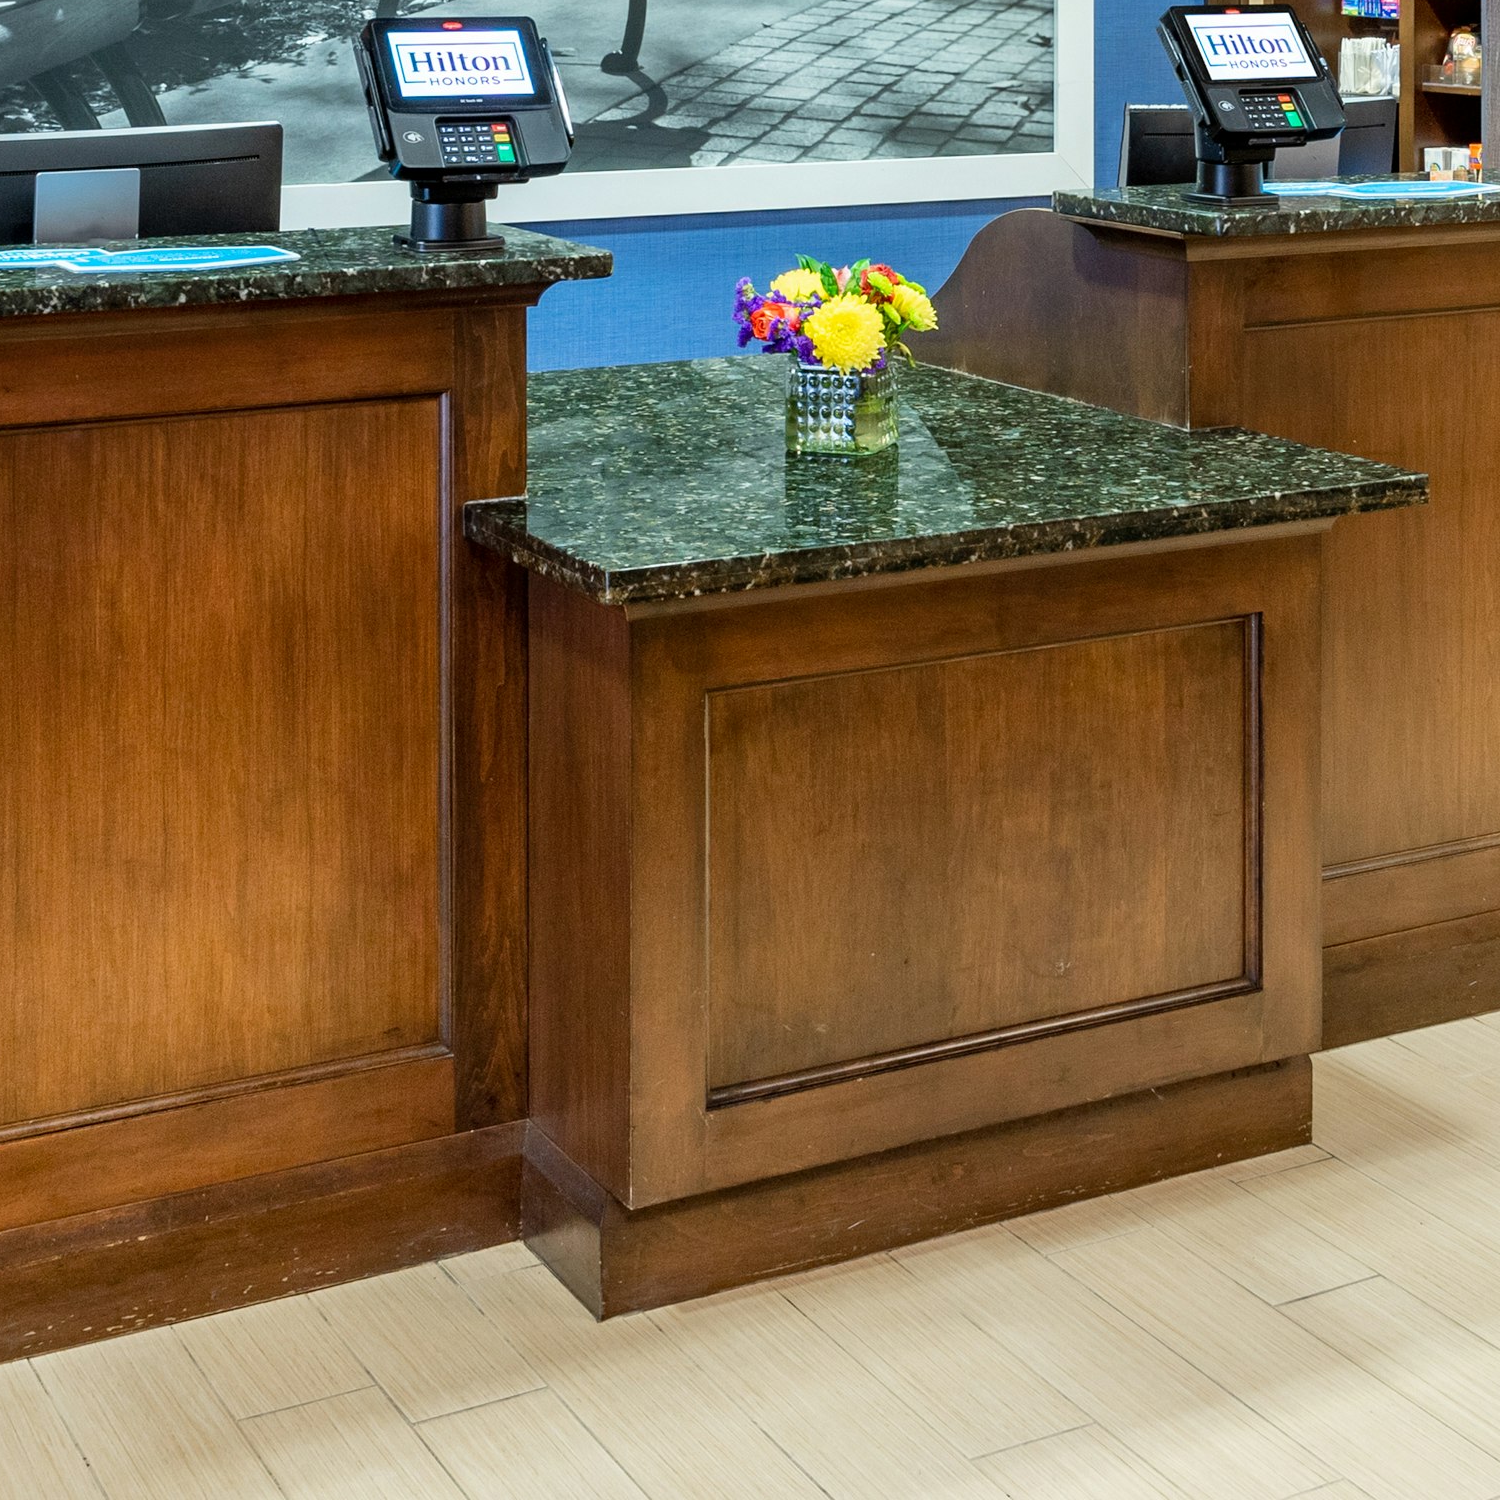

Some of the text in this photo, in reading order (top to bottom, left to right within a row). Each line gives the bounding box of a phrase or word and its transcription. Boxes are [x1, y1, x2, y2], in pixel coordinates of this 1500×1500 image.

[1205, 34, 1293, 55] Hilton
[408, 51, 512, 73] Hilton
[1228, 58, 1288, 69] HONORS
[429, 75, 501, 86] HONORS
